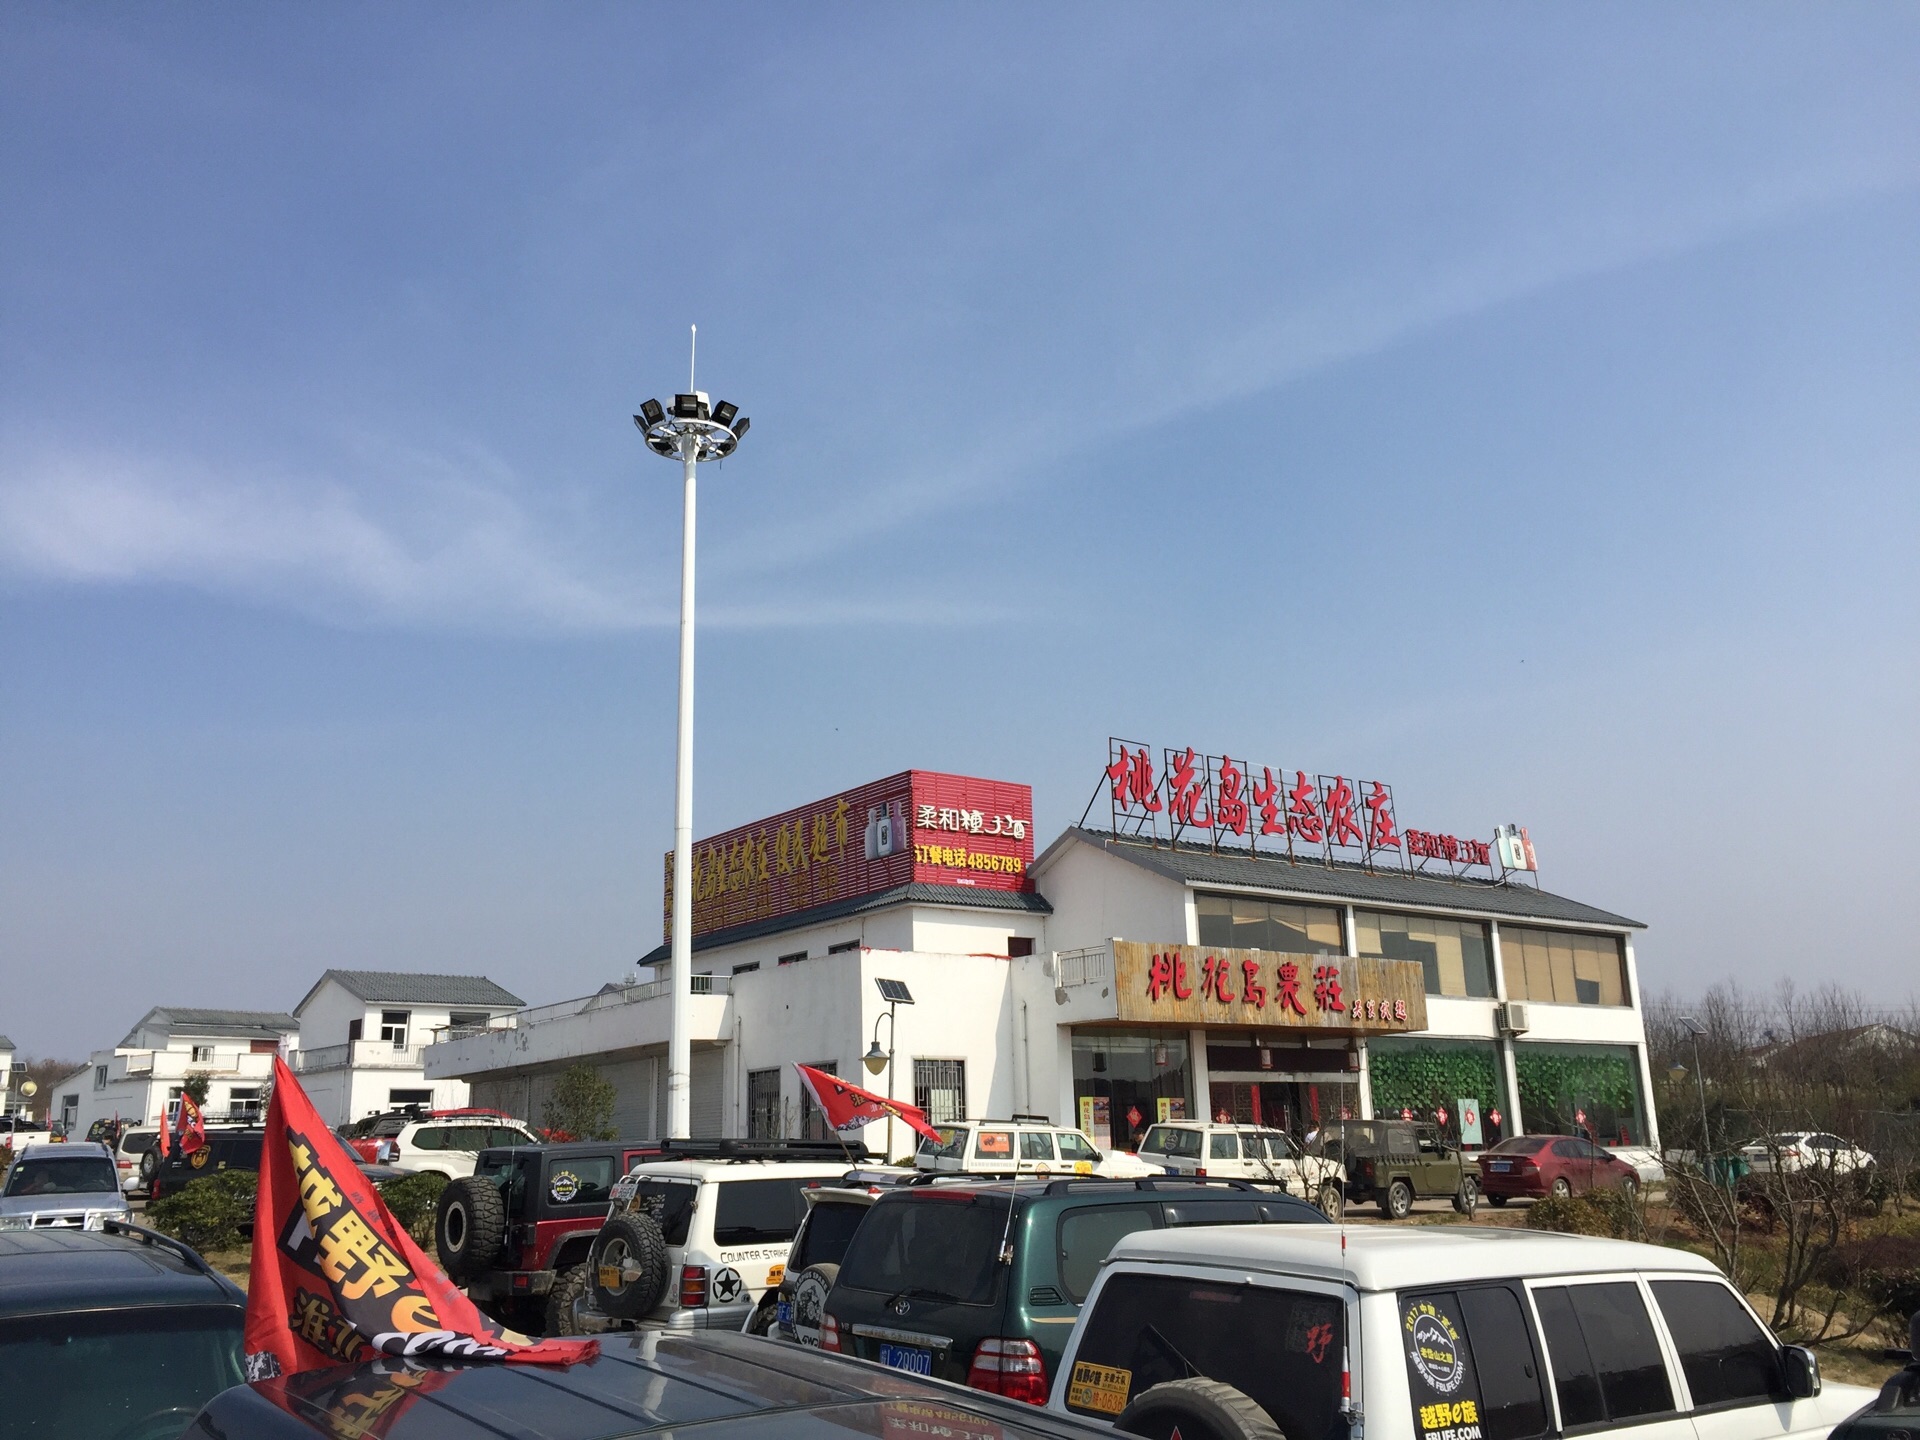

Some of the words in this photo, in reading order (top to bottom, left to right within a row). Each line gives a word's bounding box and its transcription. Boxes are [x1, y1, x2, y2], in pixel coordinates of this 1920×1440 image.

[1107, 744, 1401, 848] 桃花岛生态农庄
[720, 1250, 762, 1264] COUNTER
[763, 1248, 789, 1260] STRIKE
[1405, 1307, 1419, 1332] 2017
[1420, 1400, 1479, 1430] 越野e族
